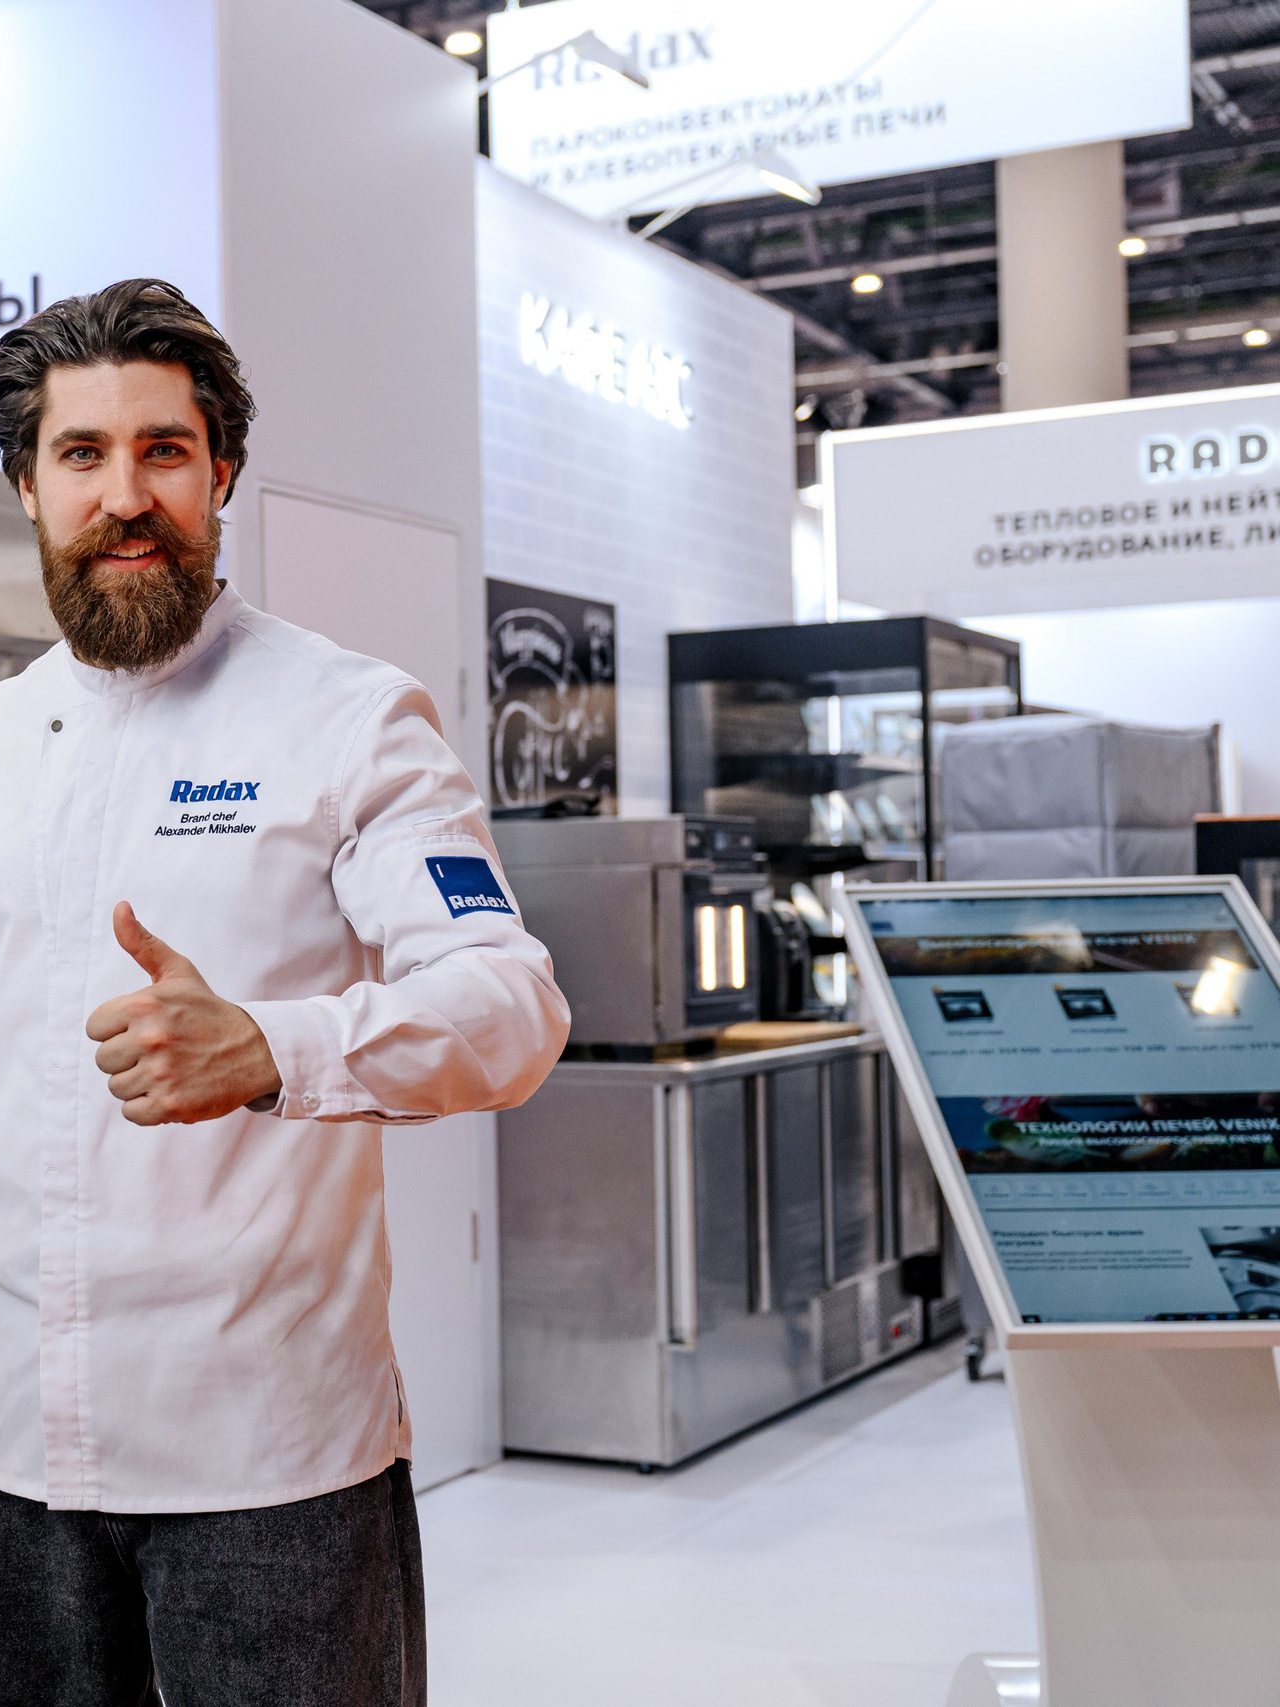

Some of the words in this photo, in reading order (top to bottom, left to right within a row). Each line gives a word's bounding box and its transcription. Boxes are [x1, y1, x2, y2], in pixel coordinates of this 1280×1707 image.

[851, 101, 948, 139] ПЕЧИ
[992, 501, 1161, 535] ТЕПЛОВОЕ
[1169, 496, 1192, 519] И
[973, 524, 1236, 568] ОБОРУДОВАНИЕ,
[170, 779, 261, 803] Radax
[180, 812, 210, 824] Brand
[212, 811, 238, 822] chef
[154, 826, 207, 837] Alexander
[208, 823, 257, 834] Mikhalev
[447, 893, 510, 910] Radax
[1015, 1120, 1151, 1135] ТЕХНОЛОГИИ
[1151, 1116, 1218, 1133] ПЕЧЕЙ
